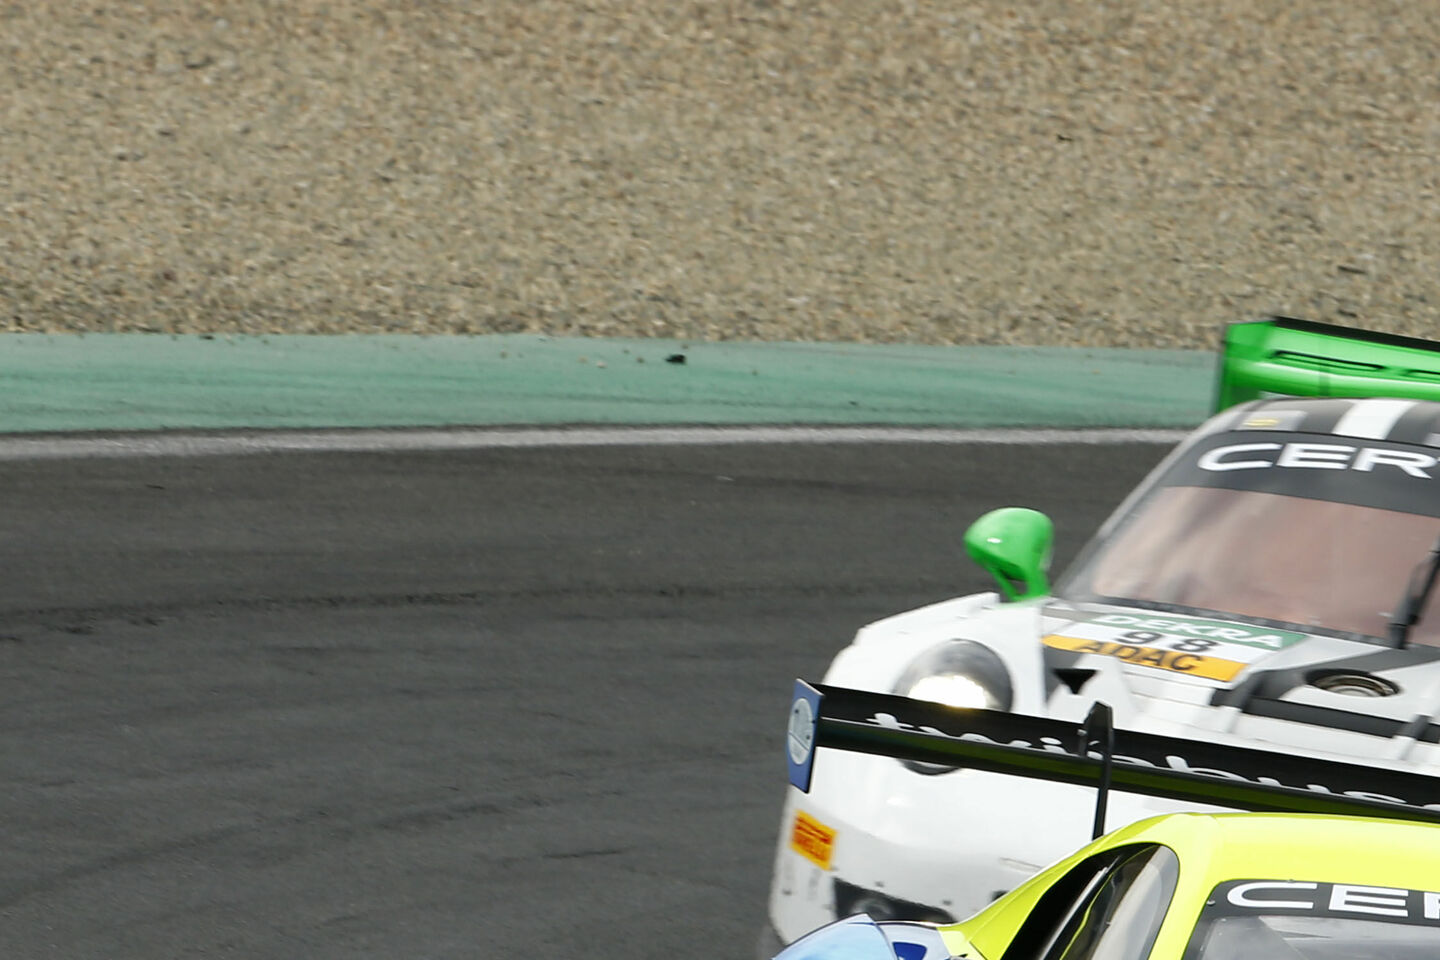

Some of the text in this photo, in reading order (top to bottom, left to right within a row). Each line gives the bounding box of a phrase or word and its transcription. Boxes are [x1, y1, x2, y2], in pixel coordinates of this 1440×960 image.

[1095, 614, 1282, 649] DEKRA
[1117, 631, 1219, 653] 98
[1077, 641, 1203, 671] ADAC
